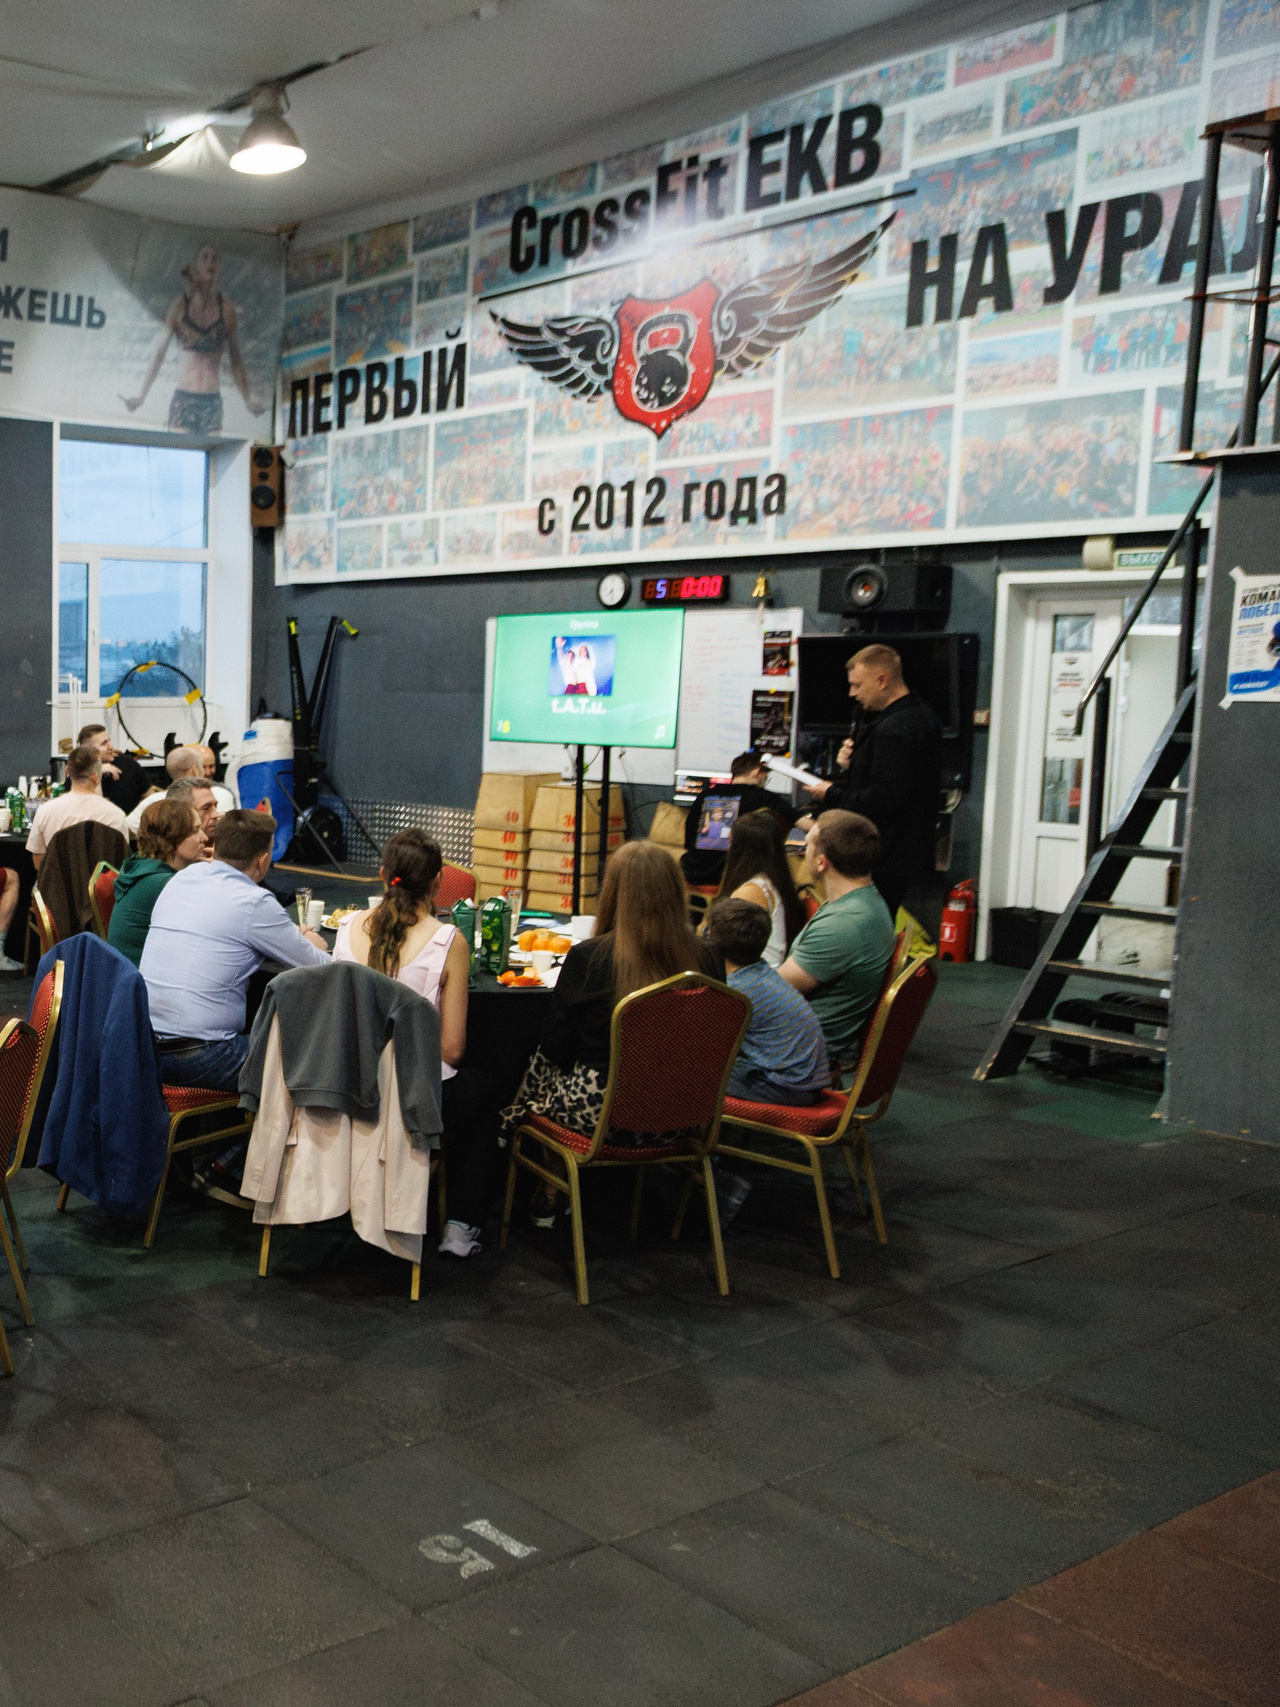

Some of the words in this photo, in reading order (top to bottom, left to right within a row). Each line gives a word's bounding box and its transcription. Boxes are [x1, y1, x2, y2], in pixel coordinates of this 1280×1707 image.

[508, 154, 733, 275] CrossFit
[286, 329, 469, 440] ПЕРВЫЙ
[905, 222, 1015, 329] НА
[570, 476, 667, 534] 2012
[680, 469, 788, 528] года
[680, 575, 723, 599] 0:00
